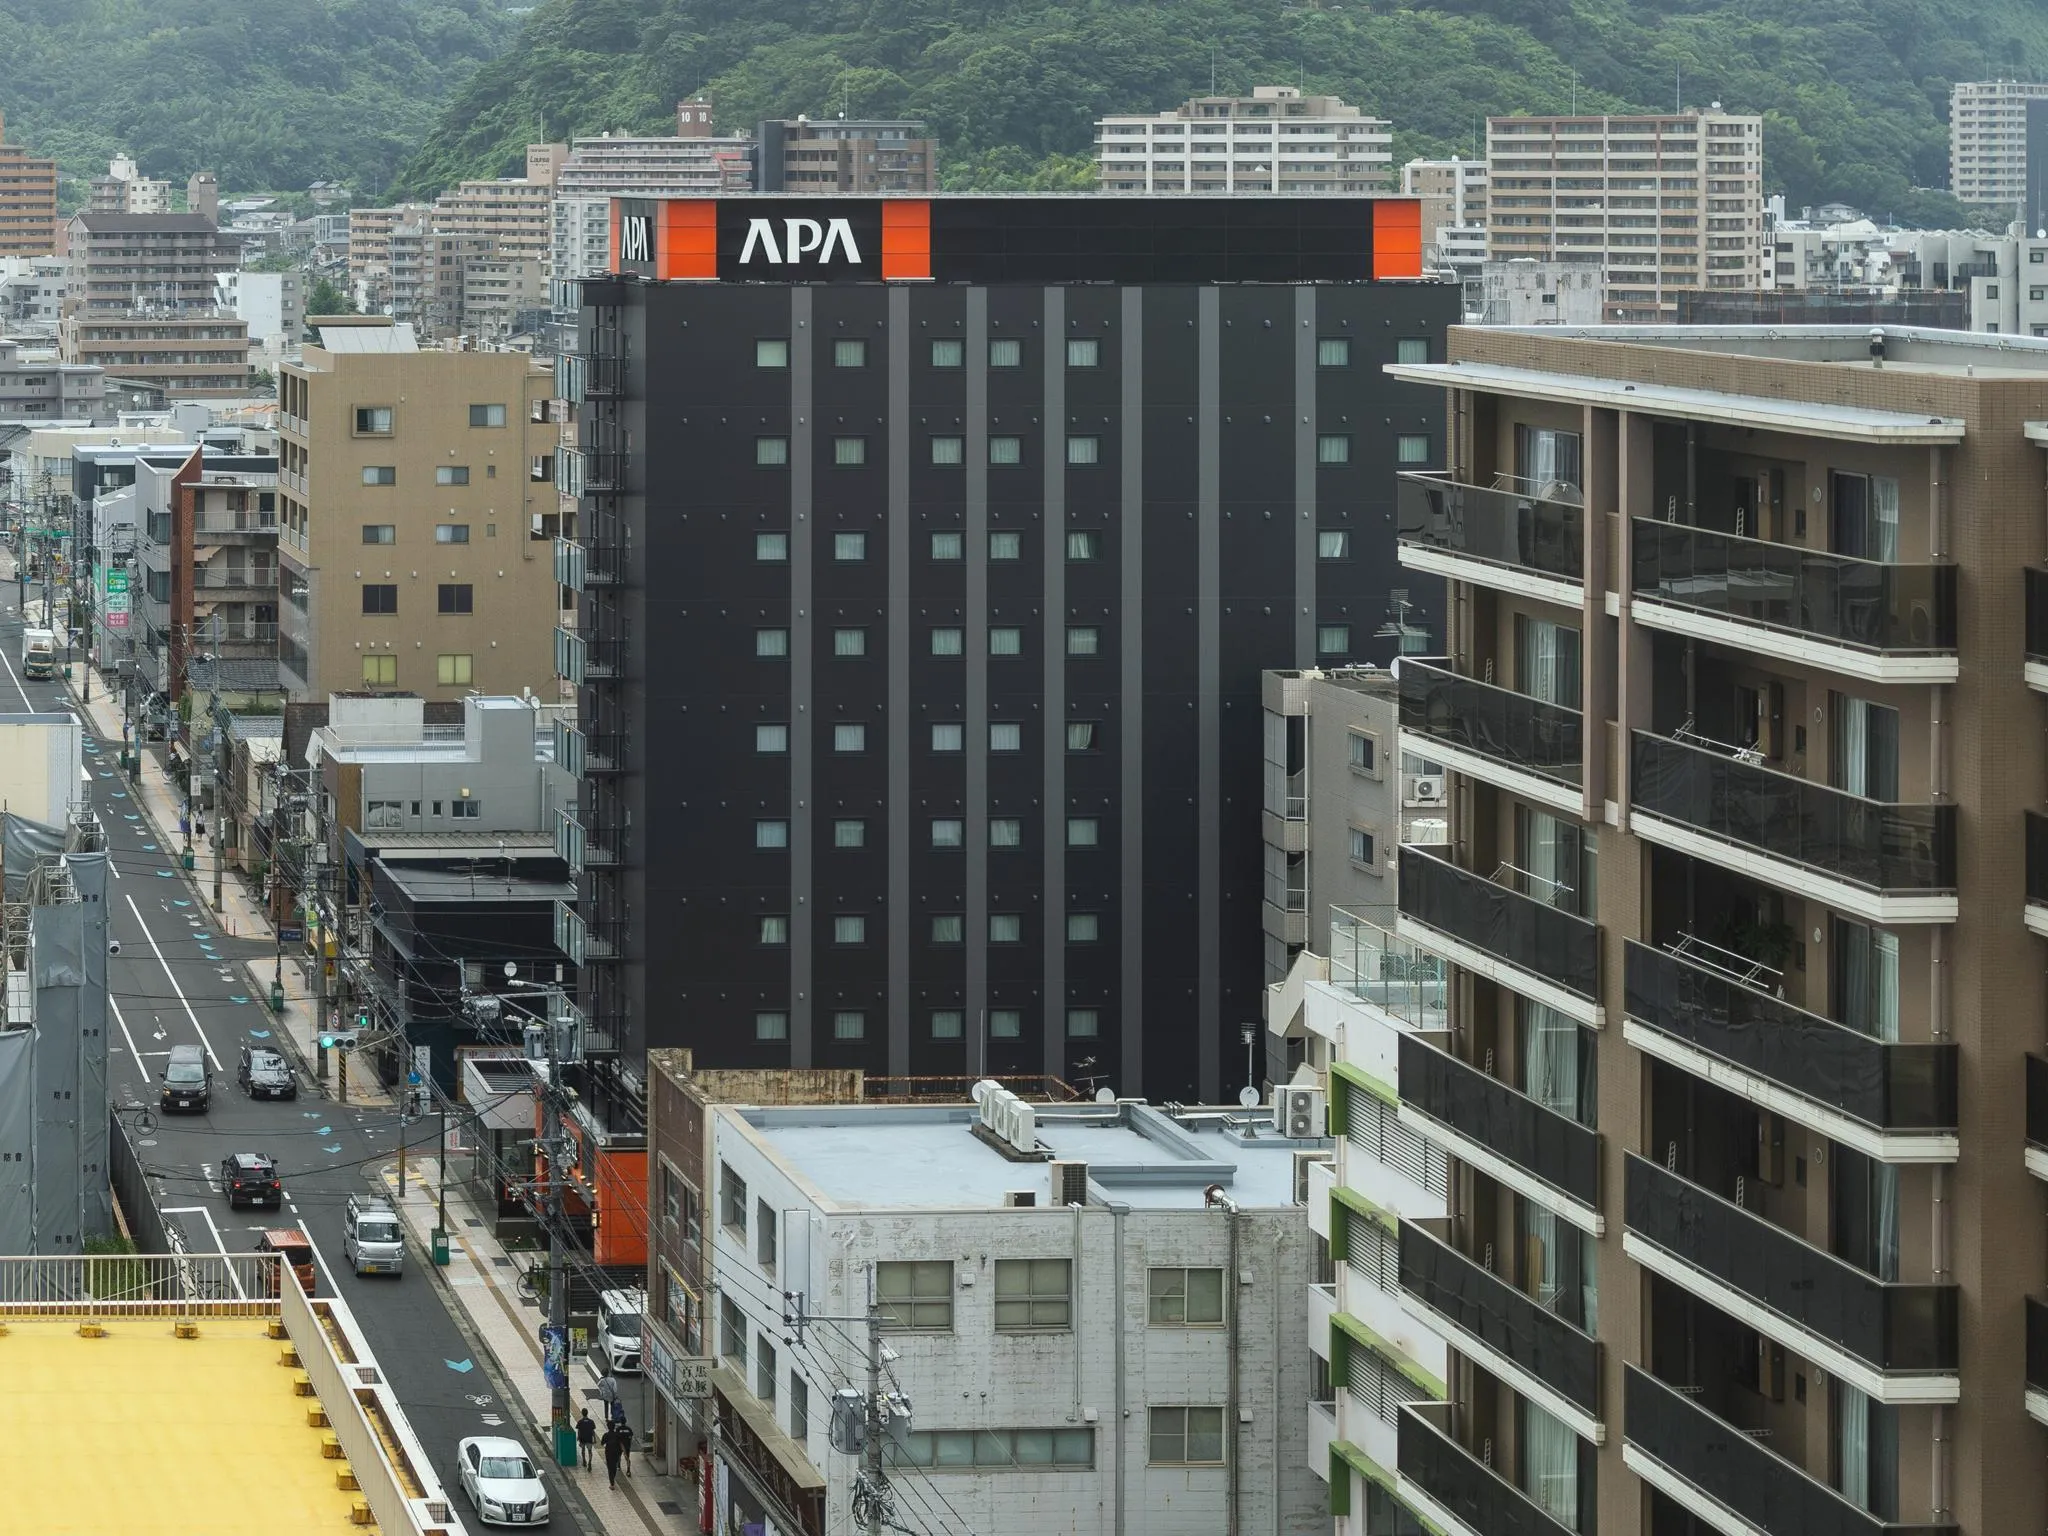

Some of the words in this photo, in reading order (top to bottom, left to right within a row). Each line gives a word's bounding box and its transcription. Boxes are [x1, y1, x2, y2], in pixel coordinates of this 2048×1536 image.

[681, 112, 691, 122] 10
[622, 216, 649, 262] APA
[739, 218, 862, 264] APA
